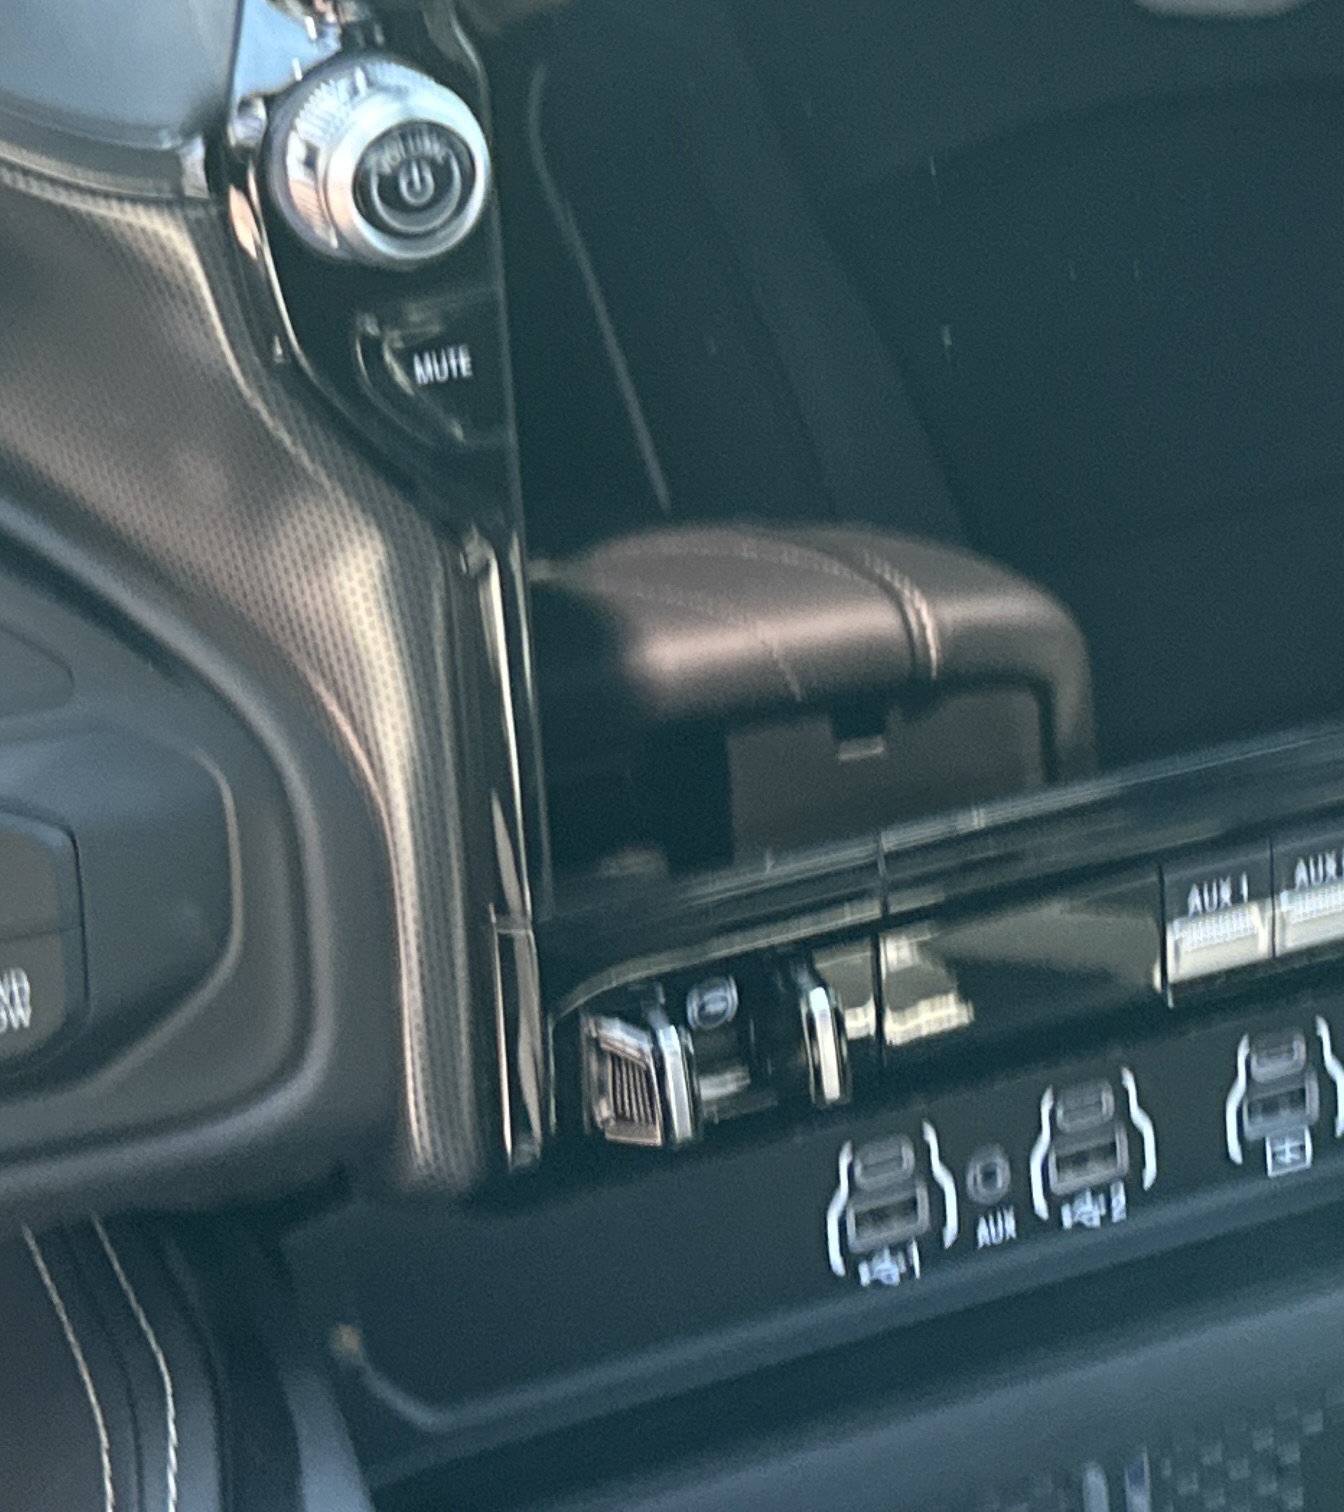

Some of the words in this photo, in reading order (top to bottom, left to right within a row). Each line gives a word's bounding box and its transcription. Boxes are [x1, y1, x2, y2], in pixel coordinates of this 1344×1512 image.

[413, 344, 472, 384] MUTE
[1294, 850, 1339, 890] AUX
[1187, 877, 1232, 918] AUX
[1240, 871, 1249, 905] 1
[977, 1205, 1017, 1250] AUX
